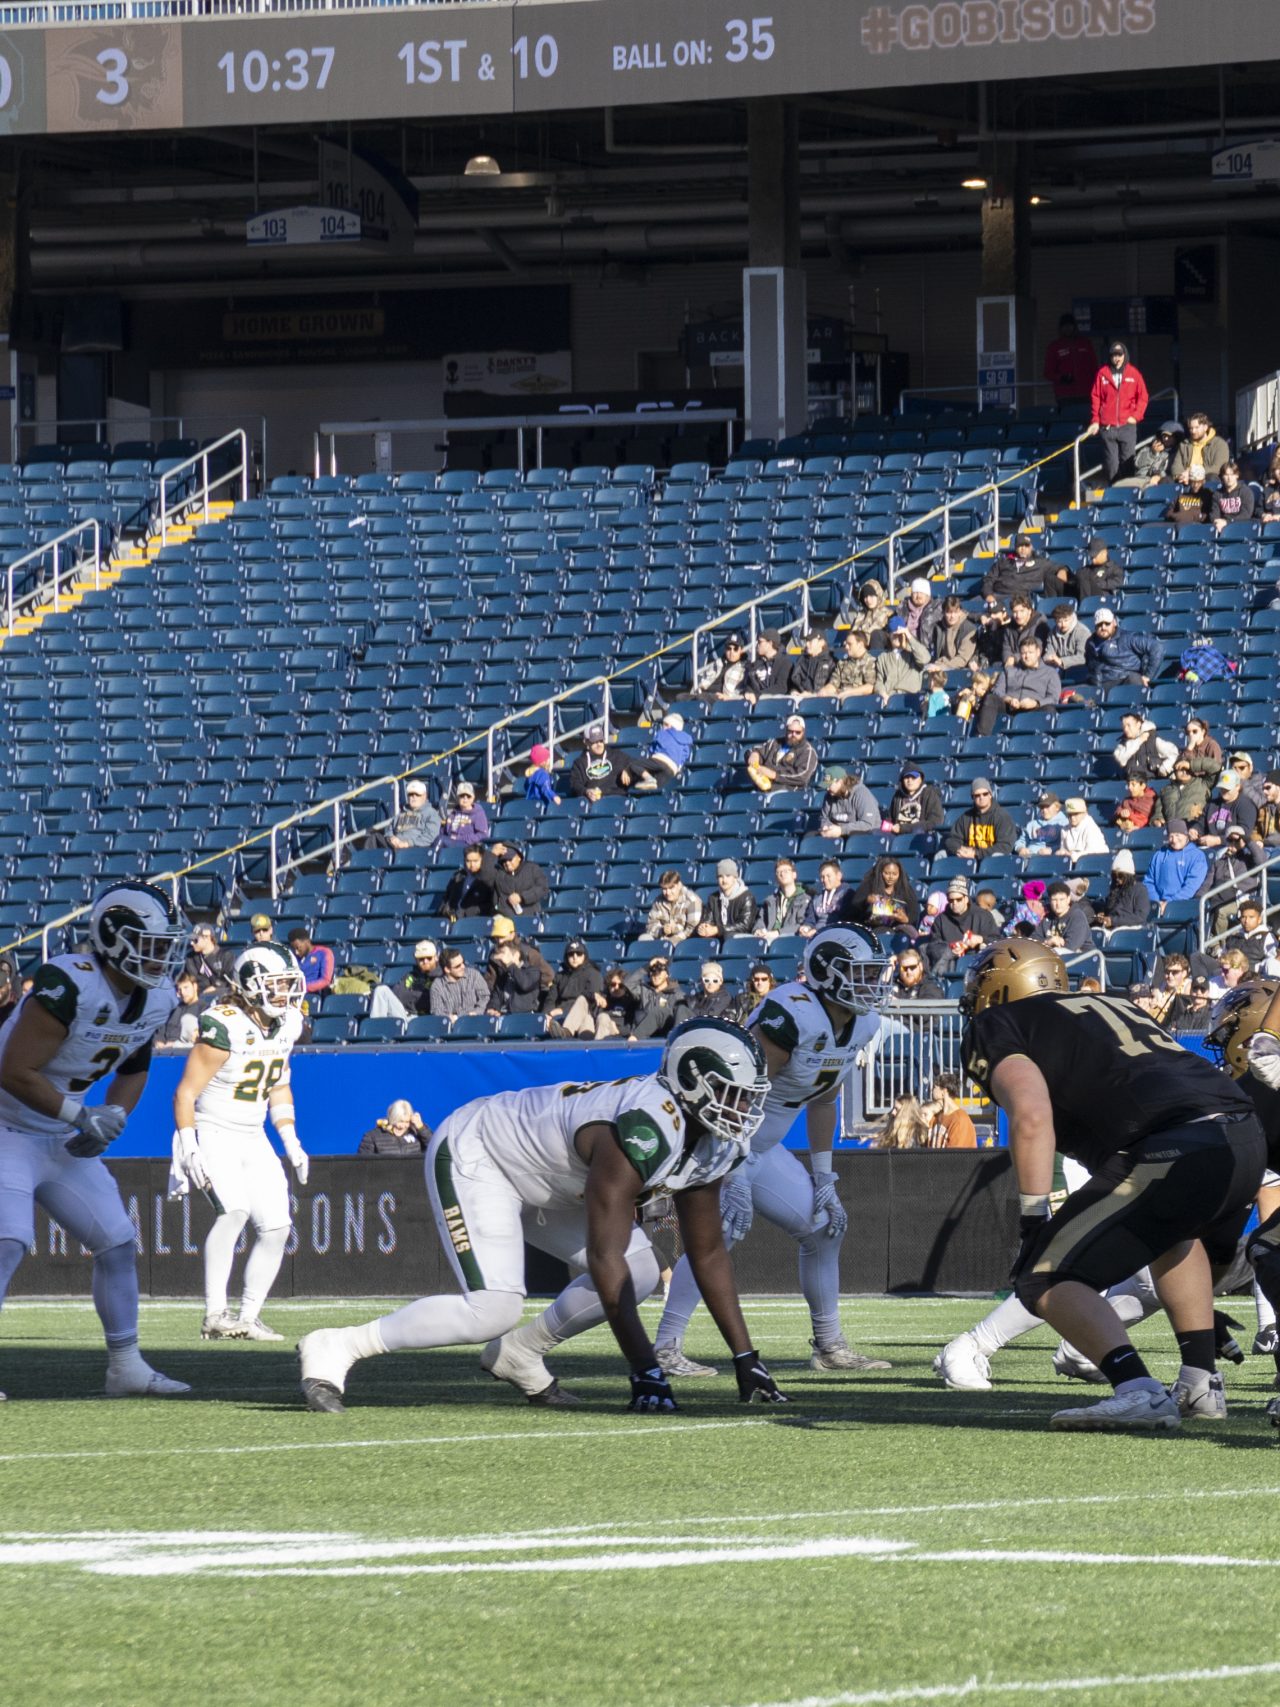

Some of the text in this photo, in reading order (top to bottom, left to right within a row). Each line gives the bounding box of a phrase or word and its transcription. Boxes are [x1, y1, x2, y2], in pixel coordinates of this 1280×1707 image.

[612, 17, 776, 71] BALL ON: 35
[861, 0, 1156, 54] #GOBISONS
[95, 48, 130, 105] 3
[217, 47, 336, 94] 10:37
[397, 34, 559, 84] 1ST & 10
[1227, 153, 1253, 173] 104
[262, 218, 288, 237] 103
[320, 215, 346, 234] 104
[232, 312, 374, 335] HOME GROWN
[1056, 995, 1187, 1057] 75
[1144, 1148, 1182, 1161] MANITOBA
[443, 1204, 472, 1254] RAMS
